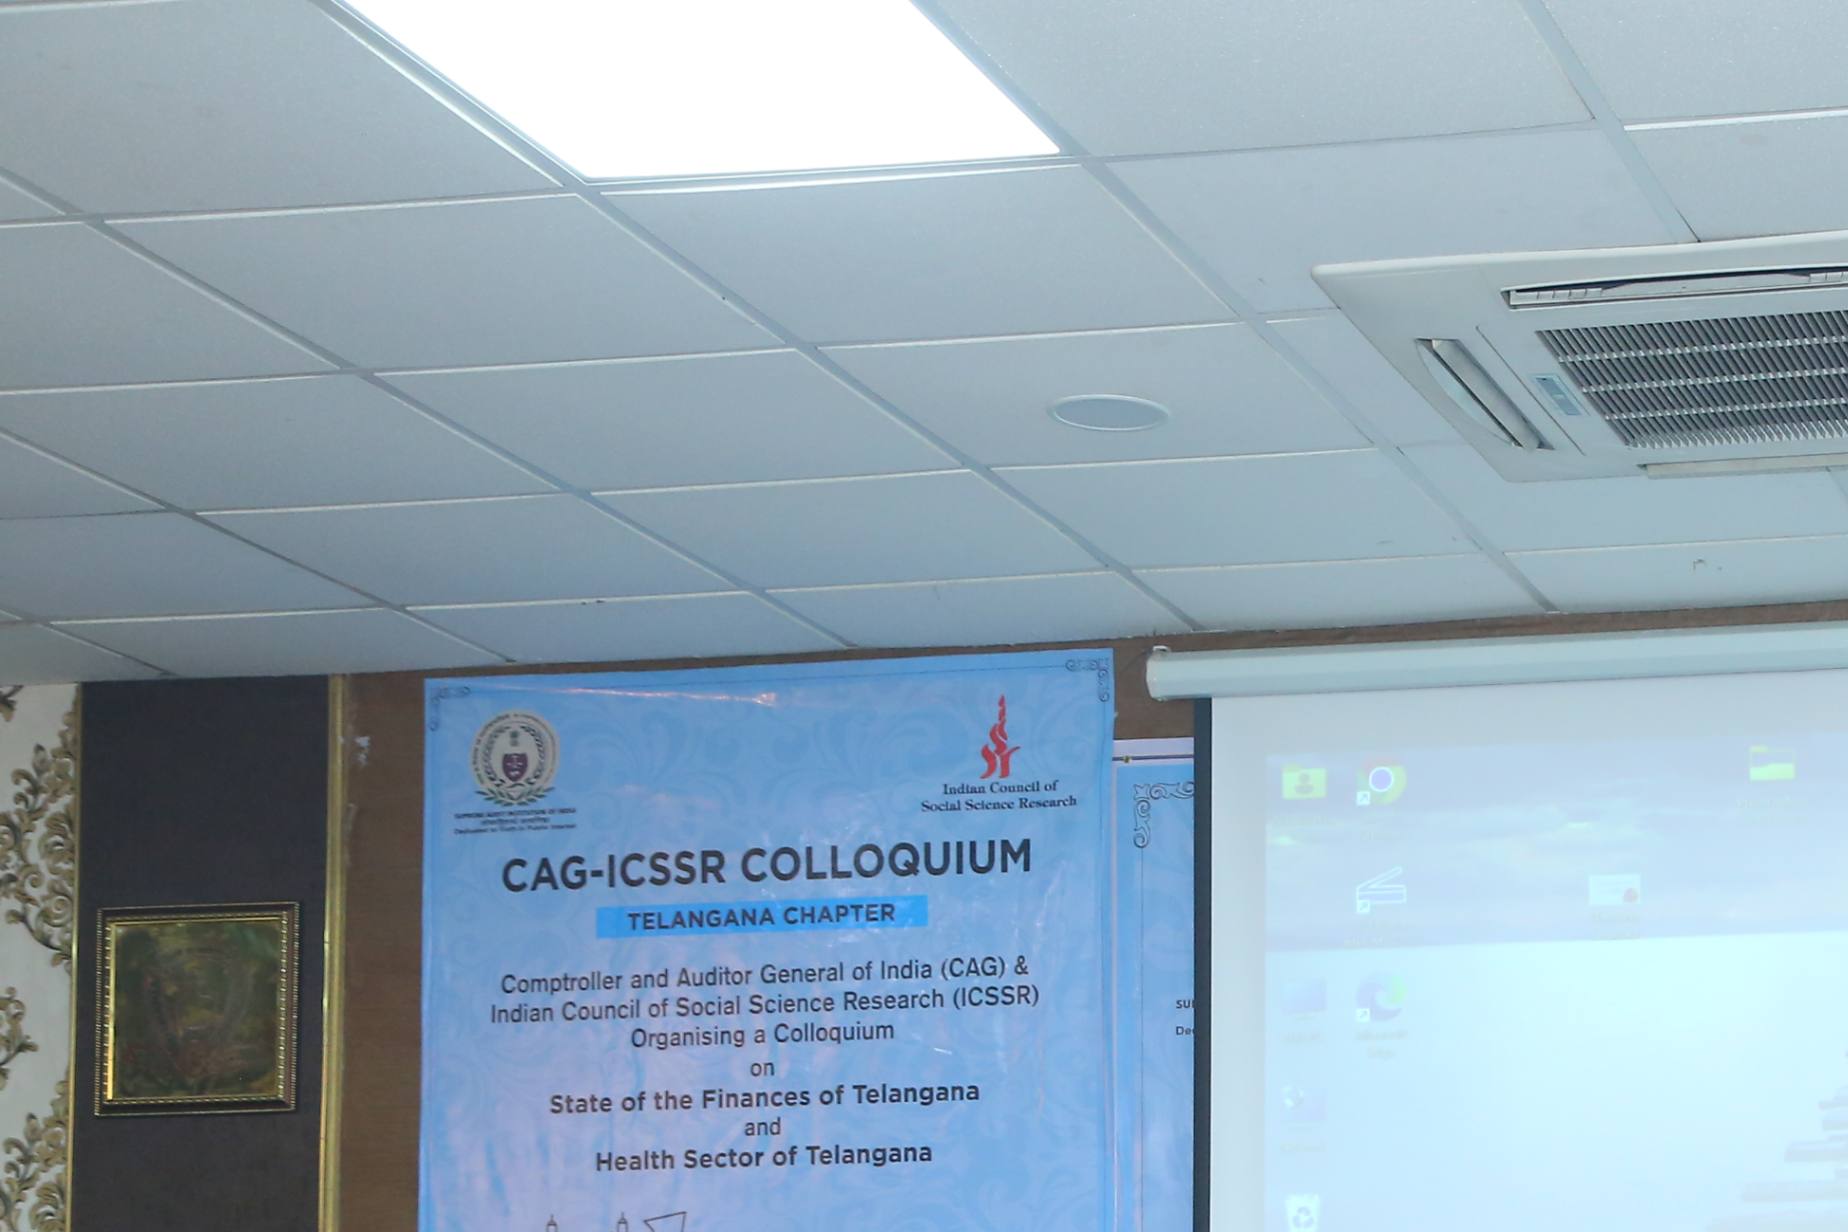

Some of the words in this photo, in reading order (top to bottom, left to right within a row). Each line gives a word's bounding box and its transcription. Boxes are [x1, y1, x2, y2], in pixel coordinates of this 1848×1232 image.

[944, 784, 986, 795] Indian
[990, 781, 1040, 793] Council
[1044, 780, 1059, 791] of
[921, 800, 961, 812] Social
[965, 799, 1014, 810] Science
[1019, 795, 1076, 808] Research
[502, 850, 725, 892] CAG-ICSSR
[741, 838, 1031, 882] COLLOQUIUM
[628, 908, 774, 930] TELANGANA
[784, 904, 895, 924] CHAPTER
[502, 971, 622, 995] Comptroller
[631, 968, 668, 989] and
[677, 966, 752, 987] Auditor
[760, 962, 843, 984] General
[852, 961, 872, 980] of
[881, 960, 932, 979] India
[941, 956, 1005, 981] (CAG)
[1014, 955, 1029, 975] &
[492, 1004, 553, 1023] Indian
[562, 999, 640, 1021] Council
[648, 998, 669, 1018] of
[676, 995, 740, 1017] Social
[749, 994, 834, 1014] Science
[844, 988, 944, 1010] Research
[953, 984, 1039, 1010] (ICSSR)
[631, 1026, 744, 1050] Organising
[754, 1029, 765, 1043] a
[774, 1021, 894, 1044] Colloquium
[750, 1062, 775, 1077] on
[550, 1094, 612, 1114] State
[621, 1091, 646, 1111] of
[654, 1090, 693, 1110] the
[703, 1089, 810, 1109] Finances
[819, 1084, 844, 1105] of
[852, 1083, 979, 1106] Telangana
[744, 1116, 781, 1136] and
[596, 1150, 674, 1171] Health
[684, 1149, 764, 1169] Sector
[772, 1145, 798, 1166] of
[805, 1144, 932, 1167] Telangana
